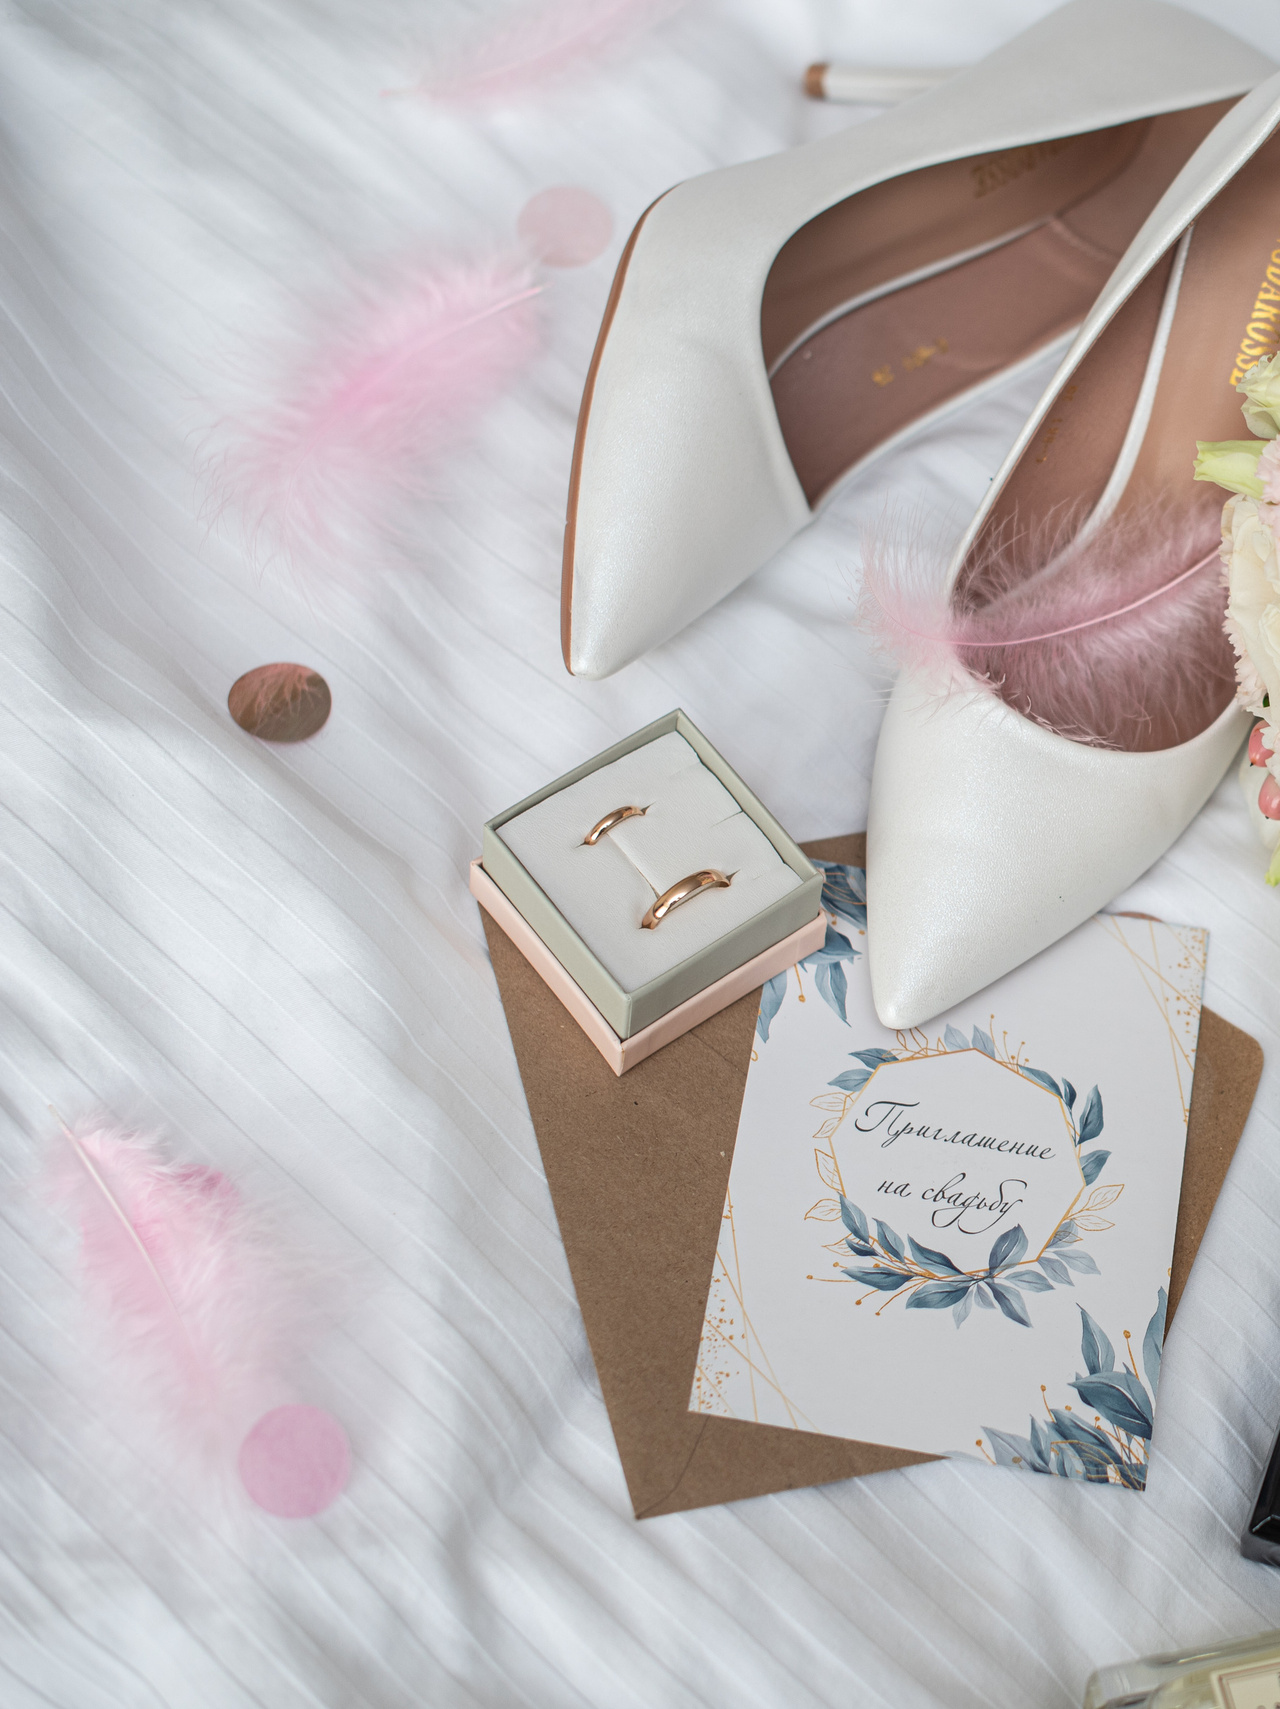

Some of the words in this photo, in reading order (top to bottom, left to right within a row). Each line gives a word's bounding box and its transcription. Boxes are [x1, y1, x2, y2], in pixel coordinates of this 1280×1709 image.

[854, 1100, 1056, 1160] Приглашение
[877, 1180, 912, 1198] на
[921, 1172, 1028, 1235] свадьбу
